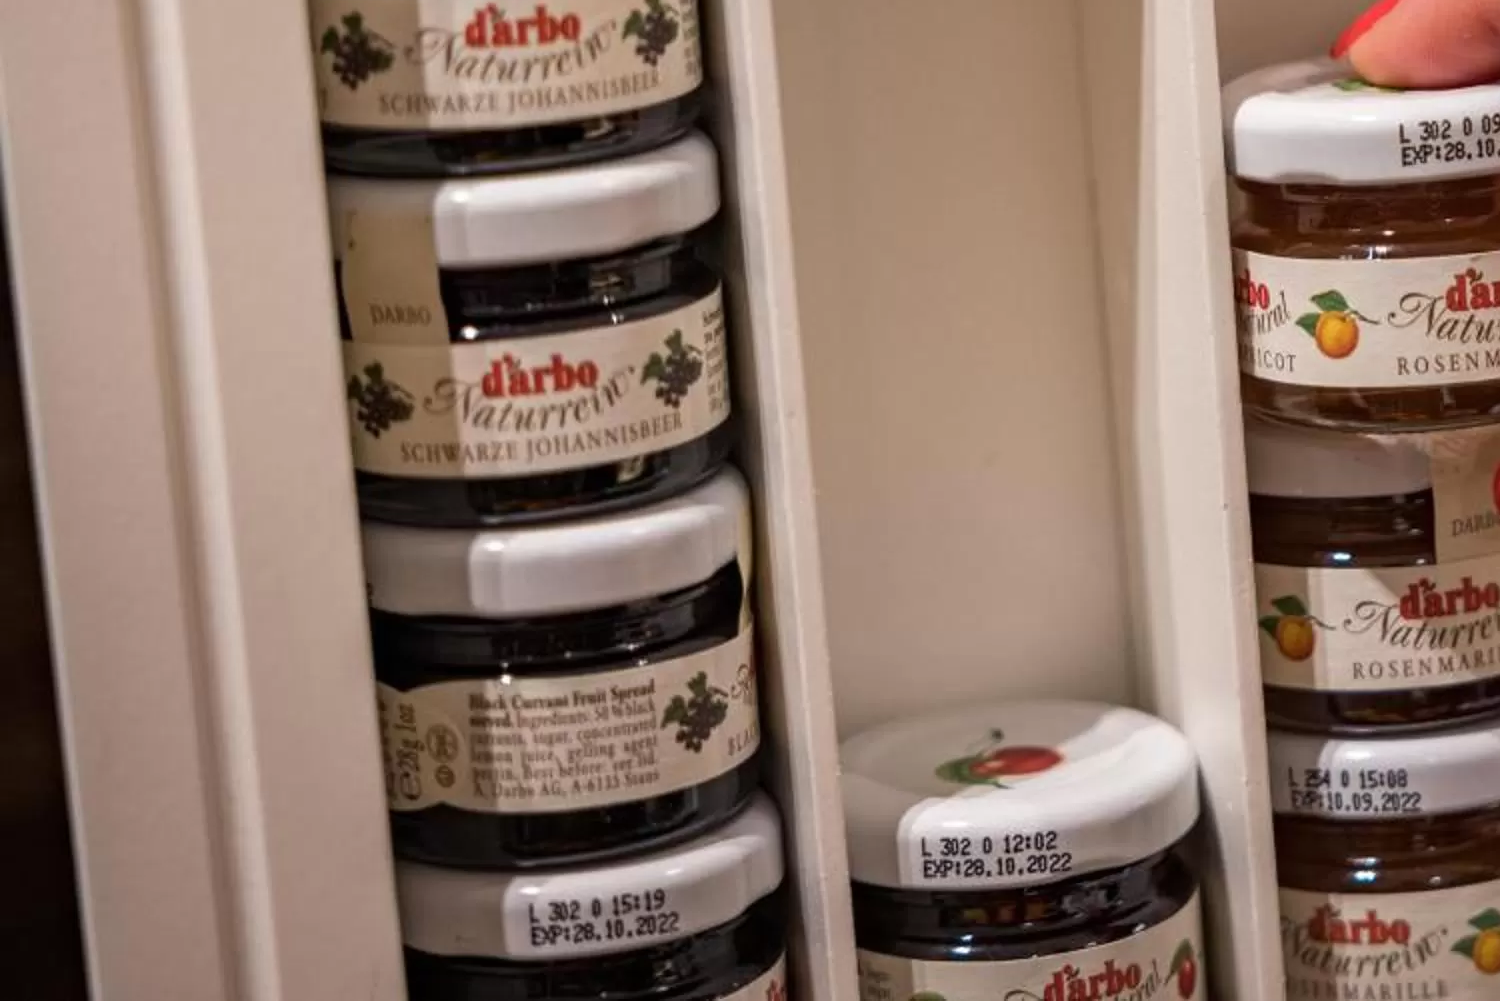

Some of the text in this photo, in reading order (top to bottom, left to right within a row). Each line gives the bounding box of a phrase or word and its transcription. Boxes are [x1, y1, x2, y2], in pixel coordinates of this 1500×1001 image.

[404, 20, 617, 86] Naturrein
[379, 70, 663, 117] SCHWARZE JOHANNISBEER
[1400, 124, 1411, 144] L
[1419, 120, 1452, 142] 302
[369, 303, 431, 326] DARBO
[424, 365, 635, 433] Naturrein
[400, 411, 683, 465] SCHWARZE JOHANNISBEER
[469, 679, 655, 711] Black Currant Fruit Spread
[1288, 767, 1298, 787] L
[1359, 768, 1408, 789] 15:08
[921, 837, 932, 857] L
[940, 837, 971, 856] 302
[1004, 831, 1058, 853] 12:02
[923, 853, 1072, 878] EXP:28.10.2022
[529, 904, 540, 923] L
[548, 900, 580, 922] 302
[612, 890, 665, 916] 15:19
[531, 911, 679, 946] EXP:28.10.2022
